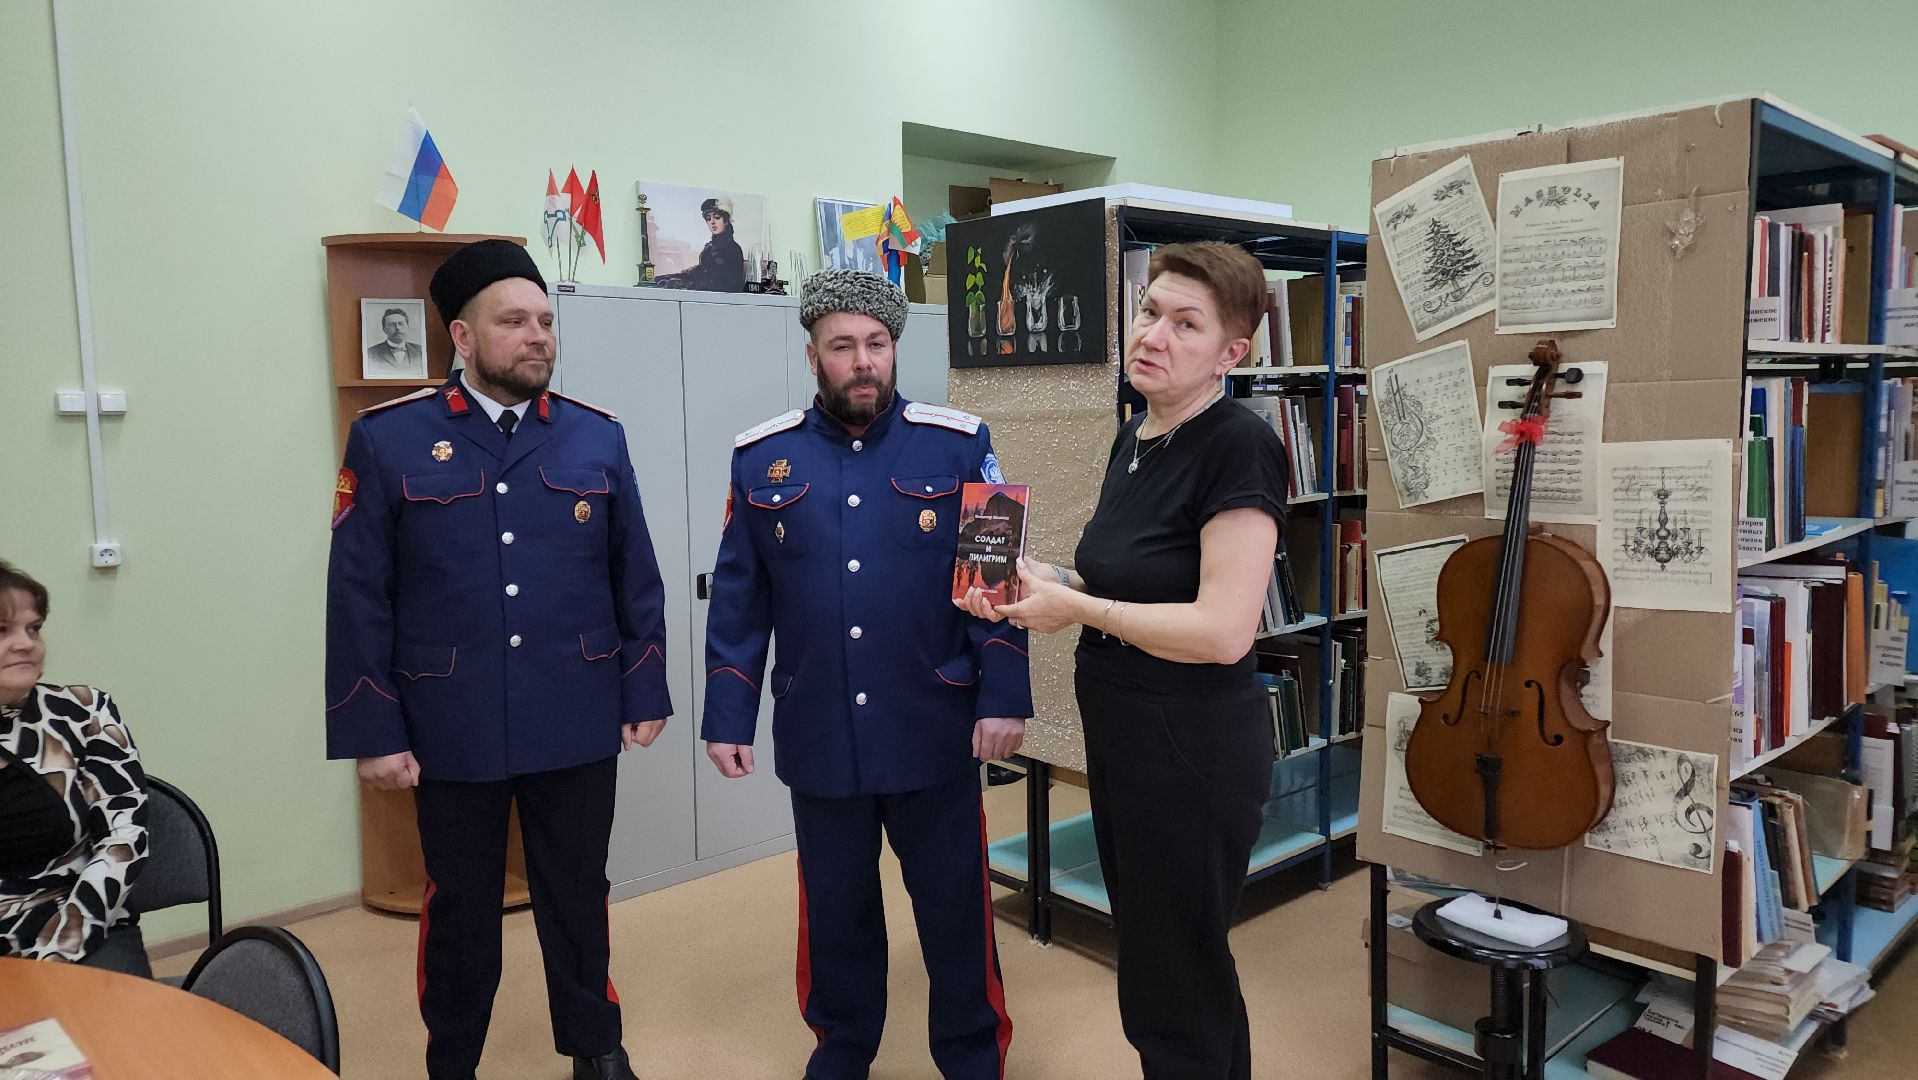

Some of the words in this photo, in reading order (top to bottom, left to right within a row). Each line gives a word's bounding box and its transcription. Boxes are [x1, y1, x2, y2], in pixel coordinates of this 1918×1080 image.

[974, 534, 1006, 545] СОЛДАТ
[985, 544, 992, 553] И
[968, 552, 1008, 564] ПИЛИГРИМ
